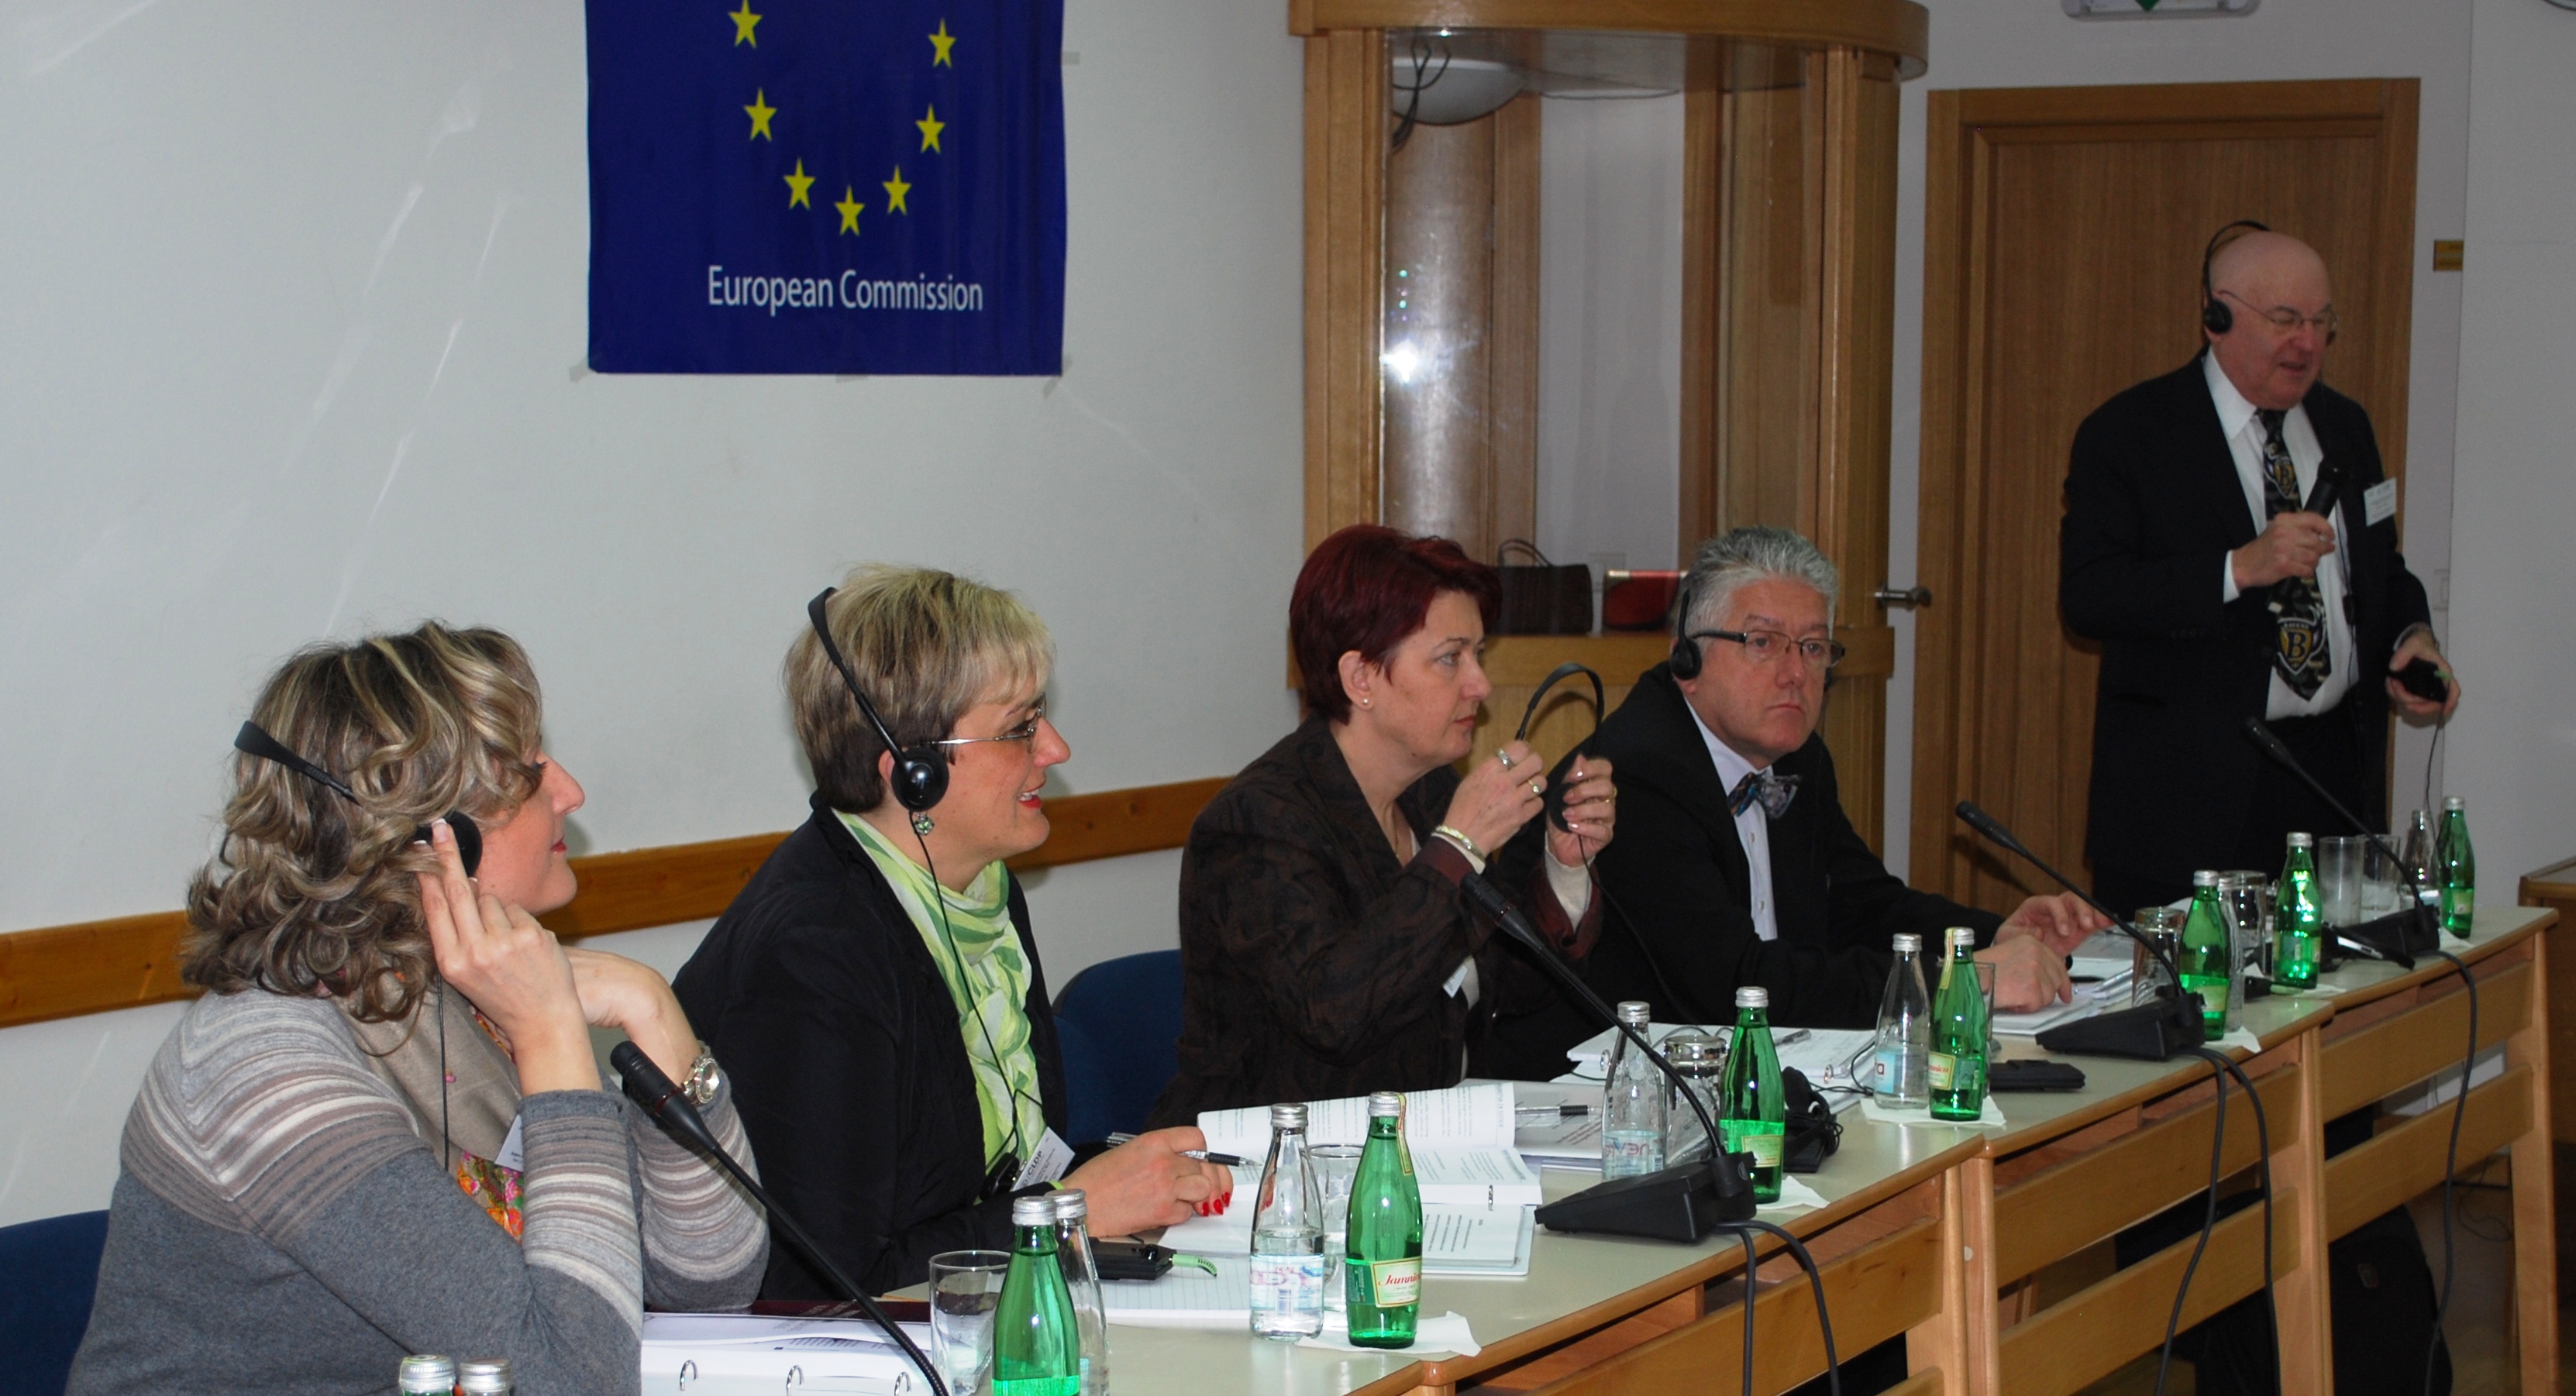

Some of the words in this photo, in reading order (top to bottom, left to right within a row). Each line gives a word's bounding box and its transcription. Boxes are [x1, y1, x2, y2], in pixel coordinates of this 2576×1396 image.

[708, 264, 833, 317] European
[839, 270, 983, 311] Commission
[2287, 631, 2307, 659] B
[1027, 1150, 1042, 1175] CLDP
